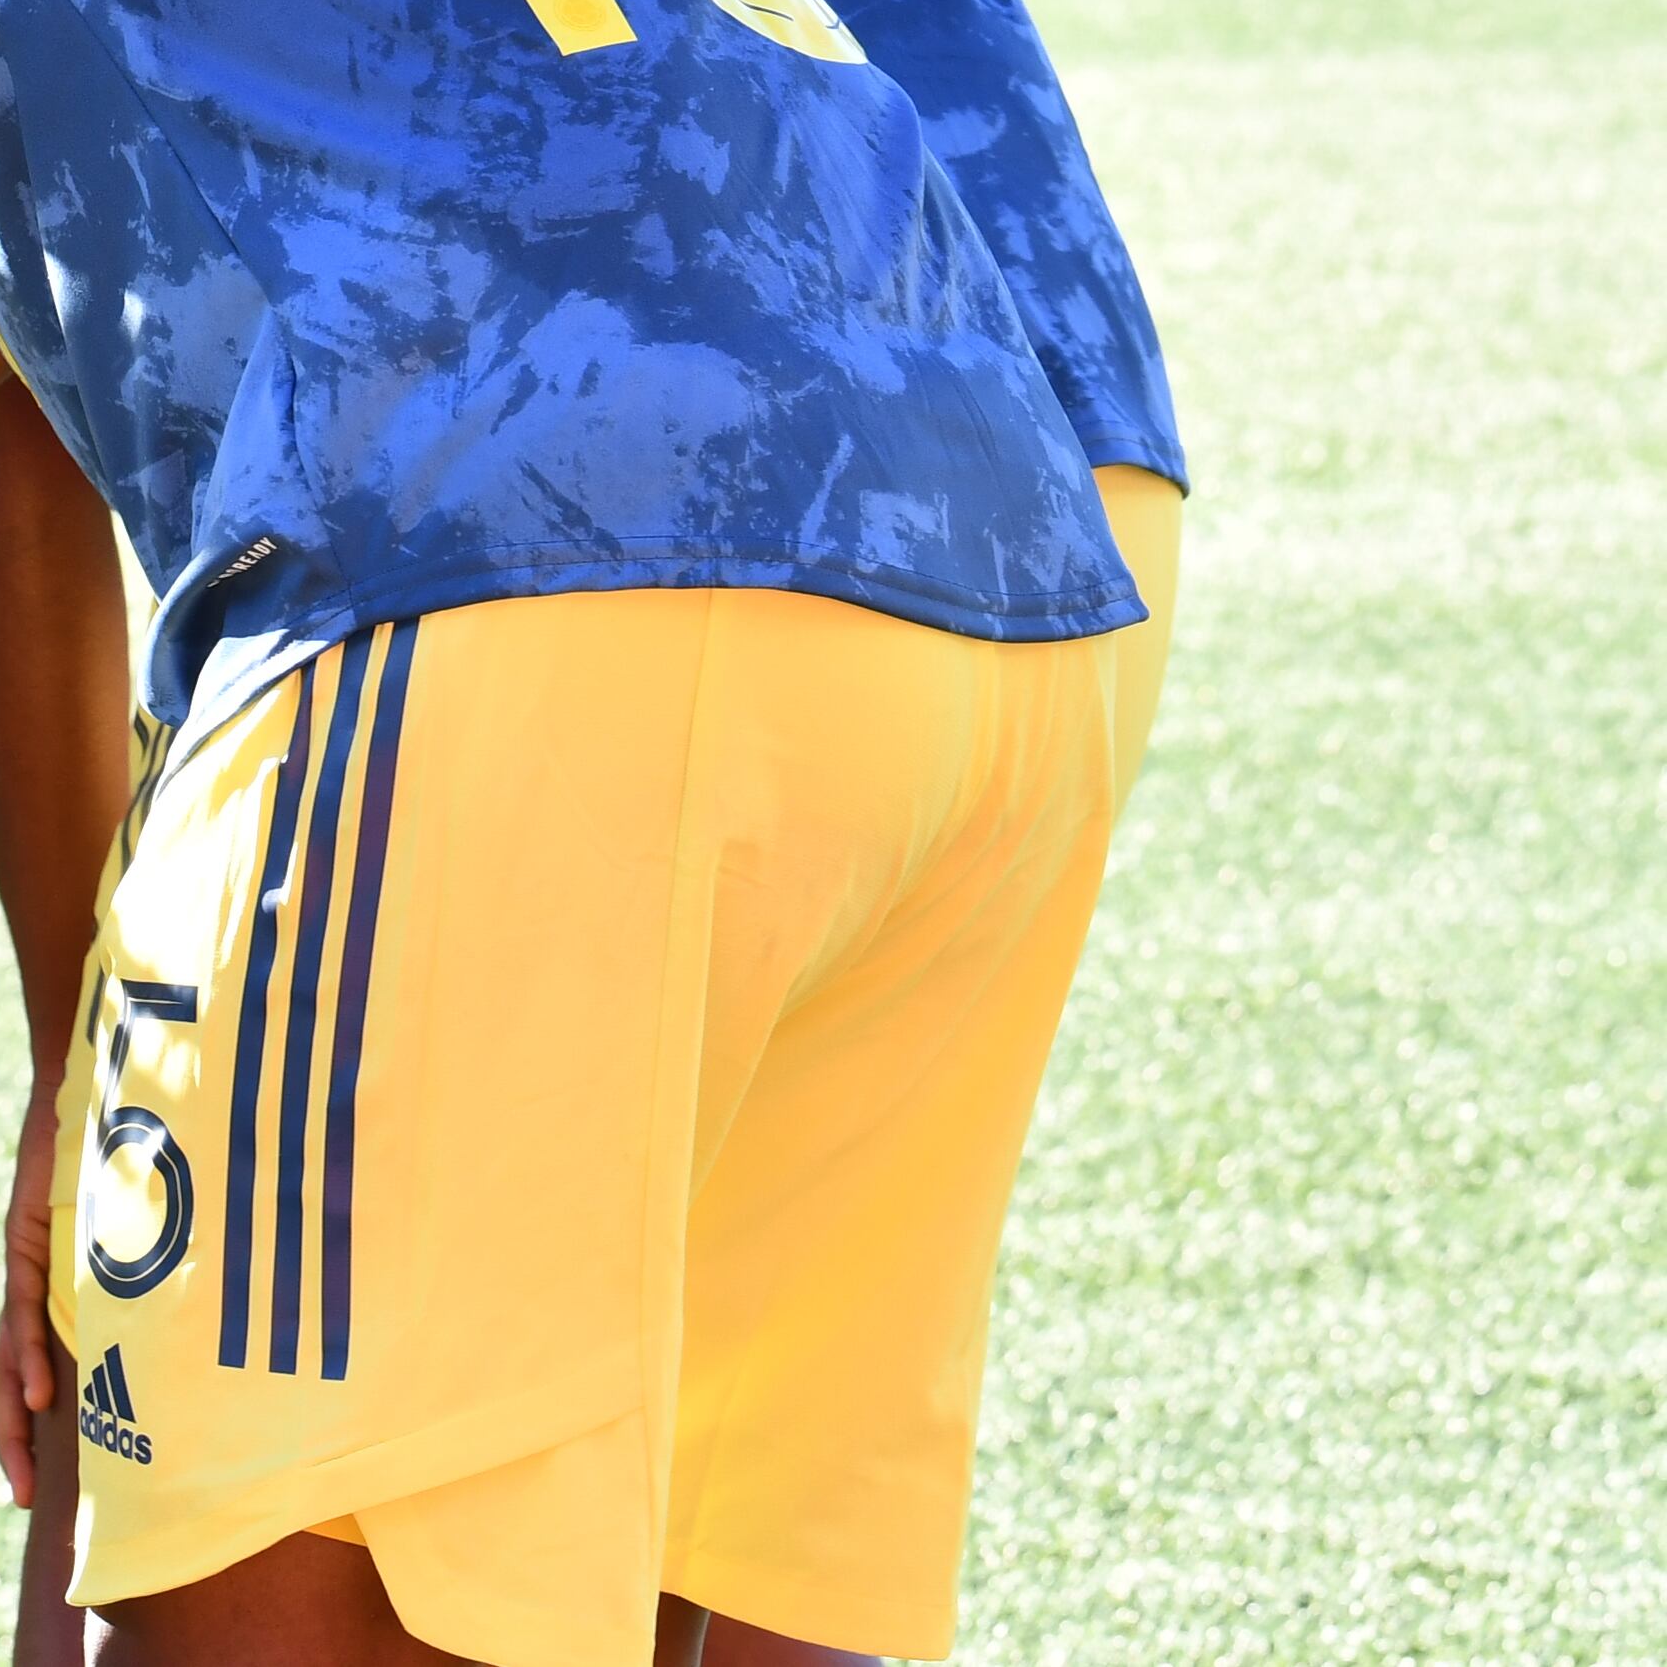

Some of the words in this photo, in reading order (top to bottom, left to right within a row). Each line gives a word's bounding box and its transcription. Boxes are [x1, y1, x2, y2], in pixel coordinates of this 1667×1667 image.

[207, 536, 278, 588] READY
[85, 978, 199, 1299] 5
[80, 1405, 153, 1465] adidas
